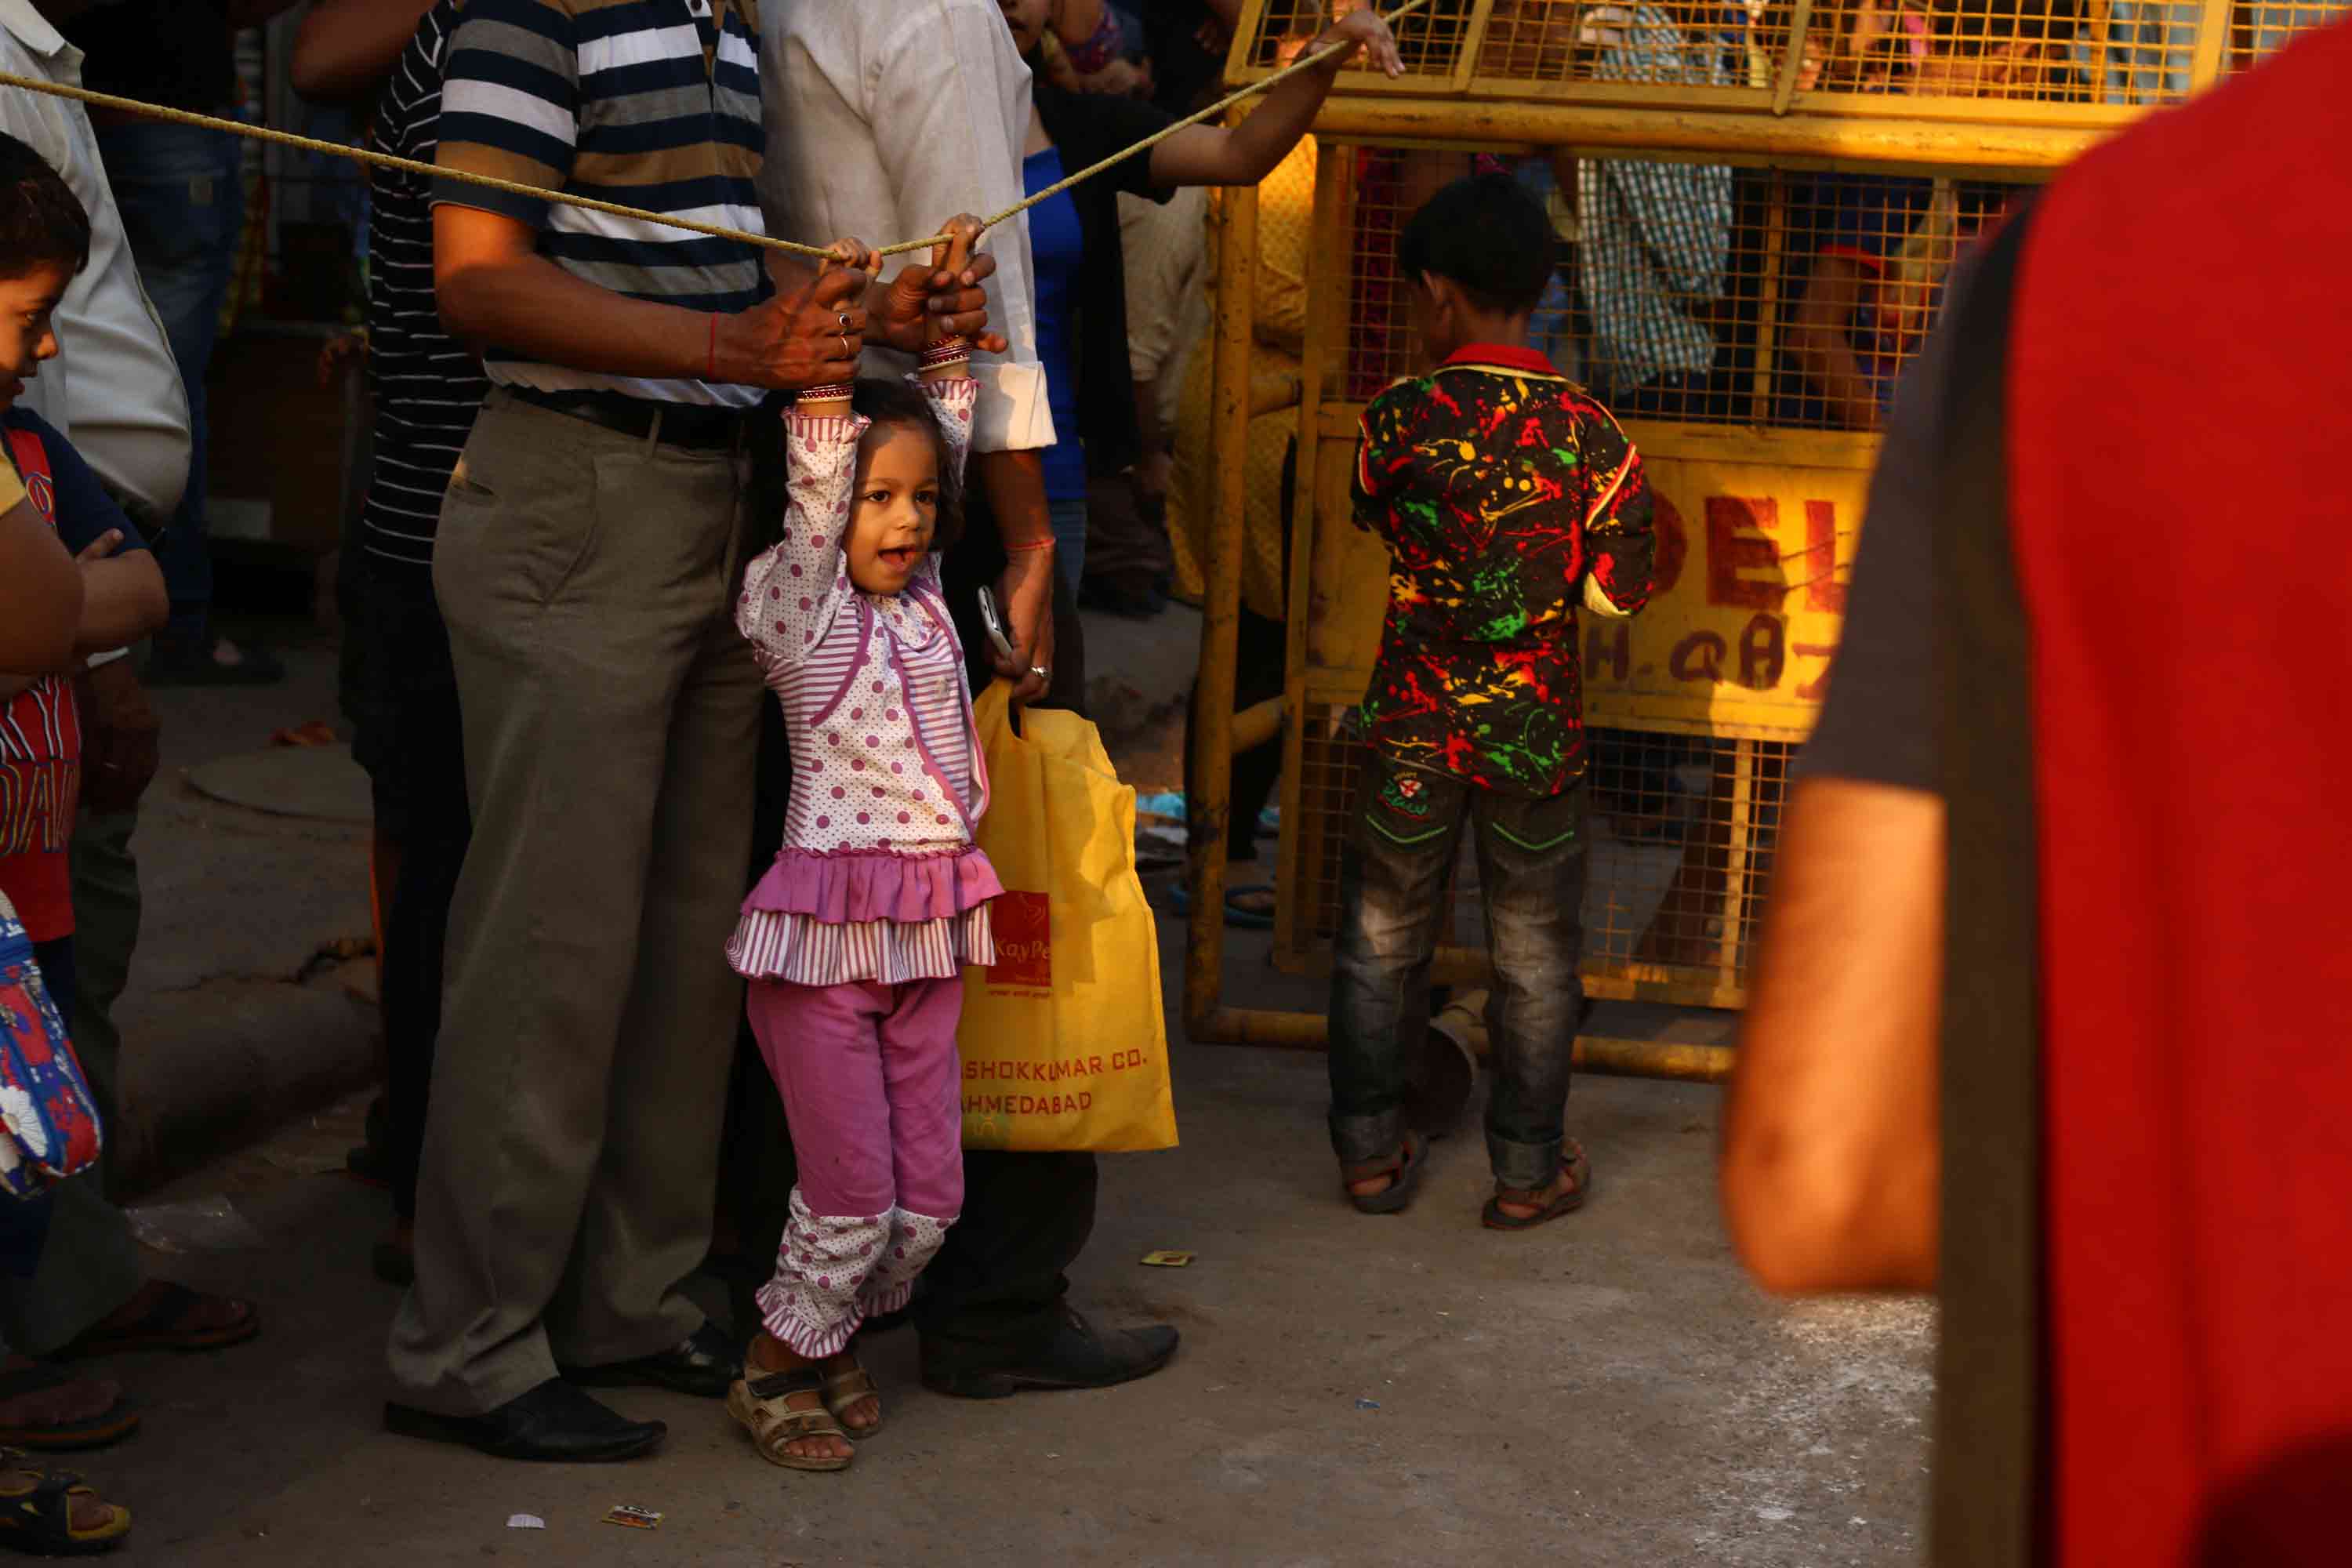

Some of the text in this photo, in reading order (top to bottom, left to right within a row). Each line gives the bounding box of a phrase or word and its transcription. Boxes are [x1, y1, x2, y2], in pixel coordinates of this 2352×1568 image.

[961, 1048, 1147, 1081] SHOKKUMAR CO.
[961, 1091, 1092, 1115] HMEDABAD
